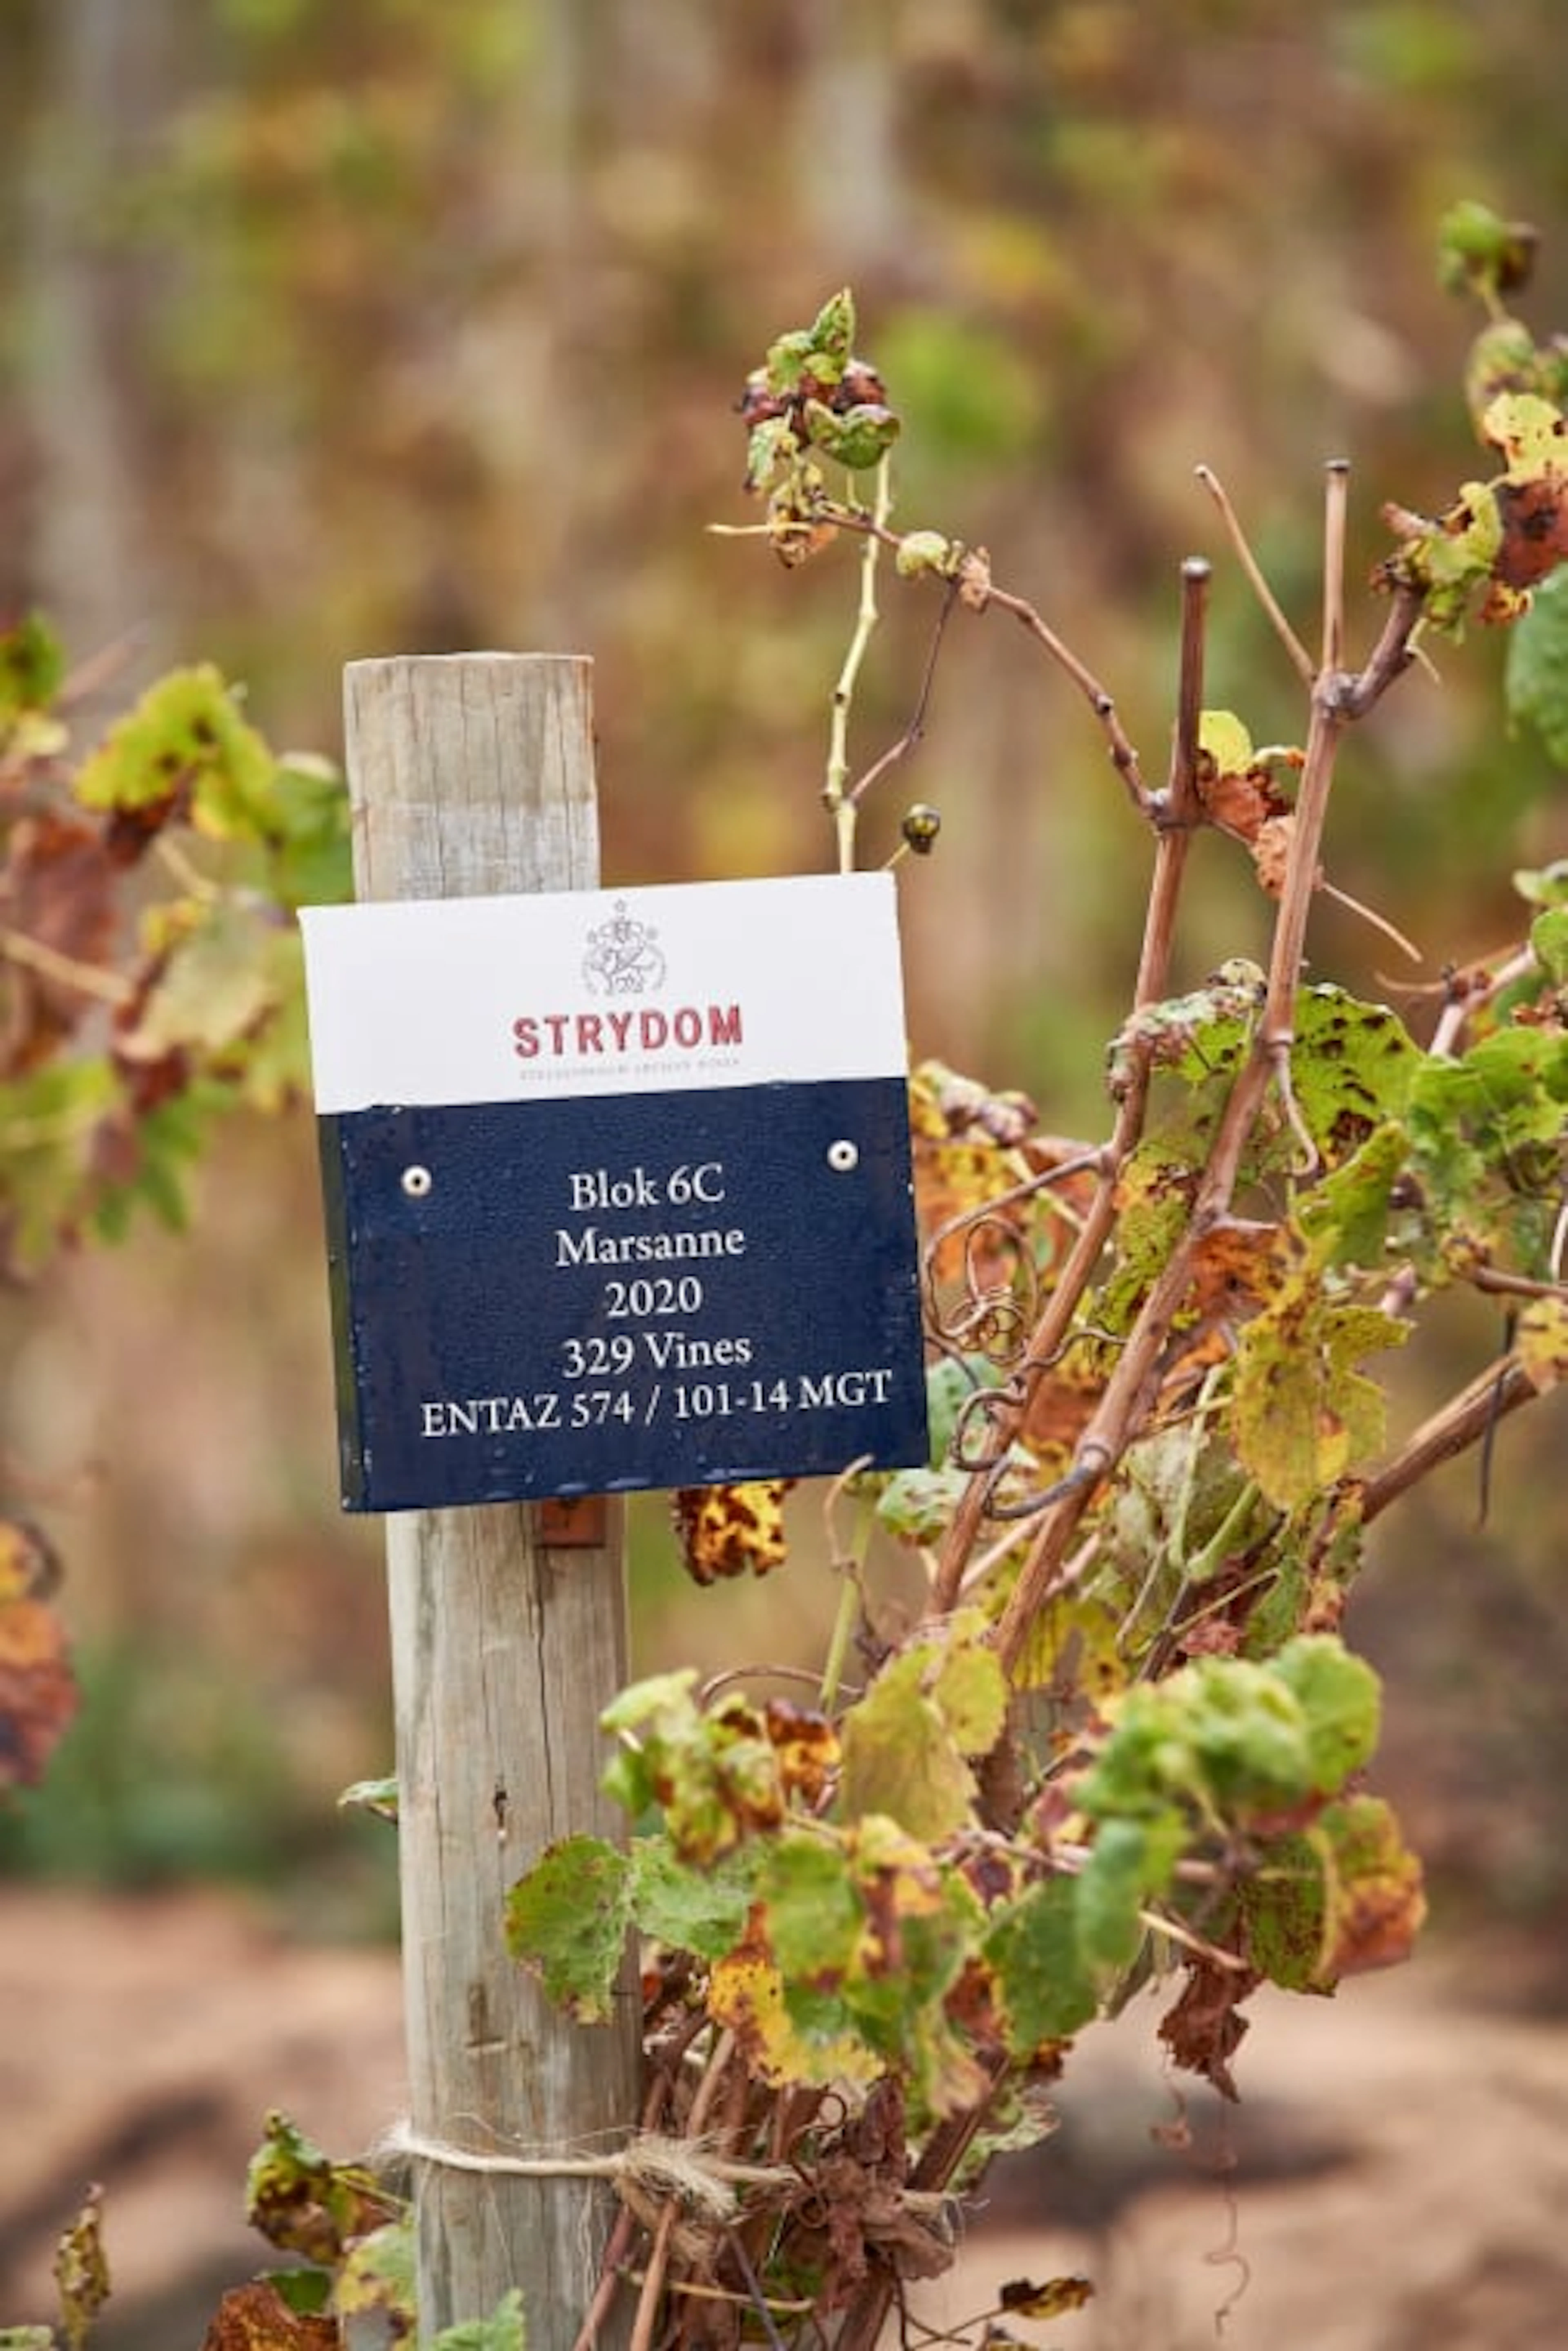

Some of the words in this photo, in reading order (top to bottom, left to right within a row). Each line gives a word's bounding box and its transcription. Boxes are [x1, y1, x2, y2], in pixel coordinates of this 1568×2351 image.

[513, 1004, 742, 1057] STRYDOM
[568, 1167, 660, 1211] Blok
[667, 1162, 726, 1204] 6C
[555, 1227, 746, 1267] Marsanne
[604, 1276, 703, 1318] 2020
[562, 1335, 635, 1379] 329
[642, 1331, 753, 1369] Vines
[421, 1394, 562, 1437] ENTAZ
[570, 1390, 635, 1428] 574
[644, 1385, 660, 1425] /
[675, 1379, 791, 1419] 101-14
[798, 1369, 893, 1410] MGT
